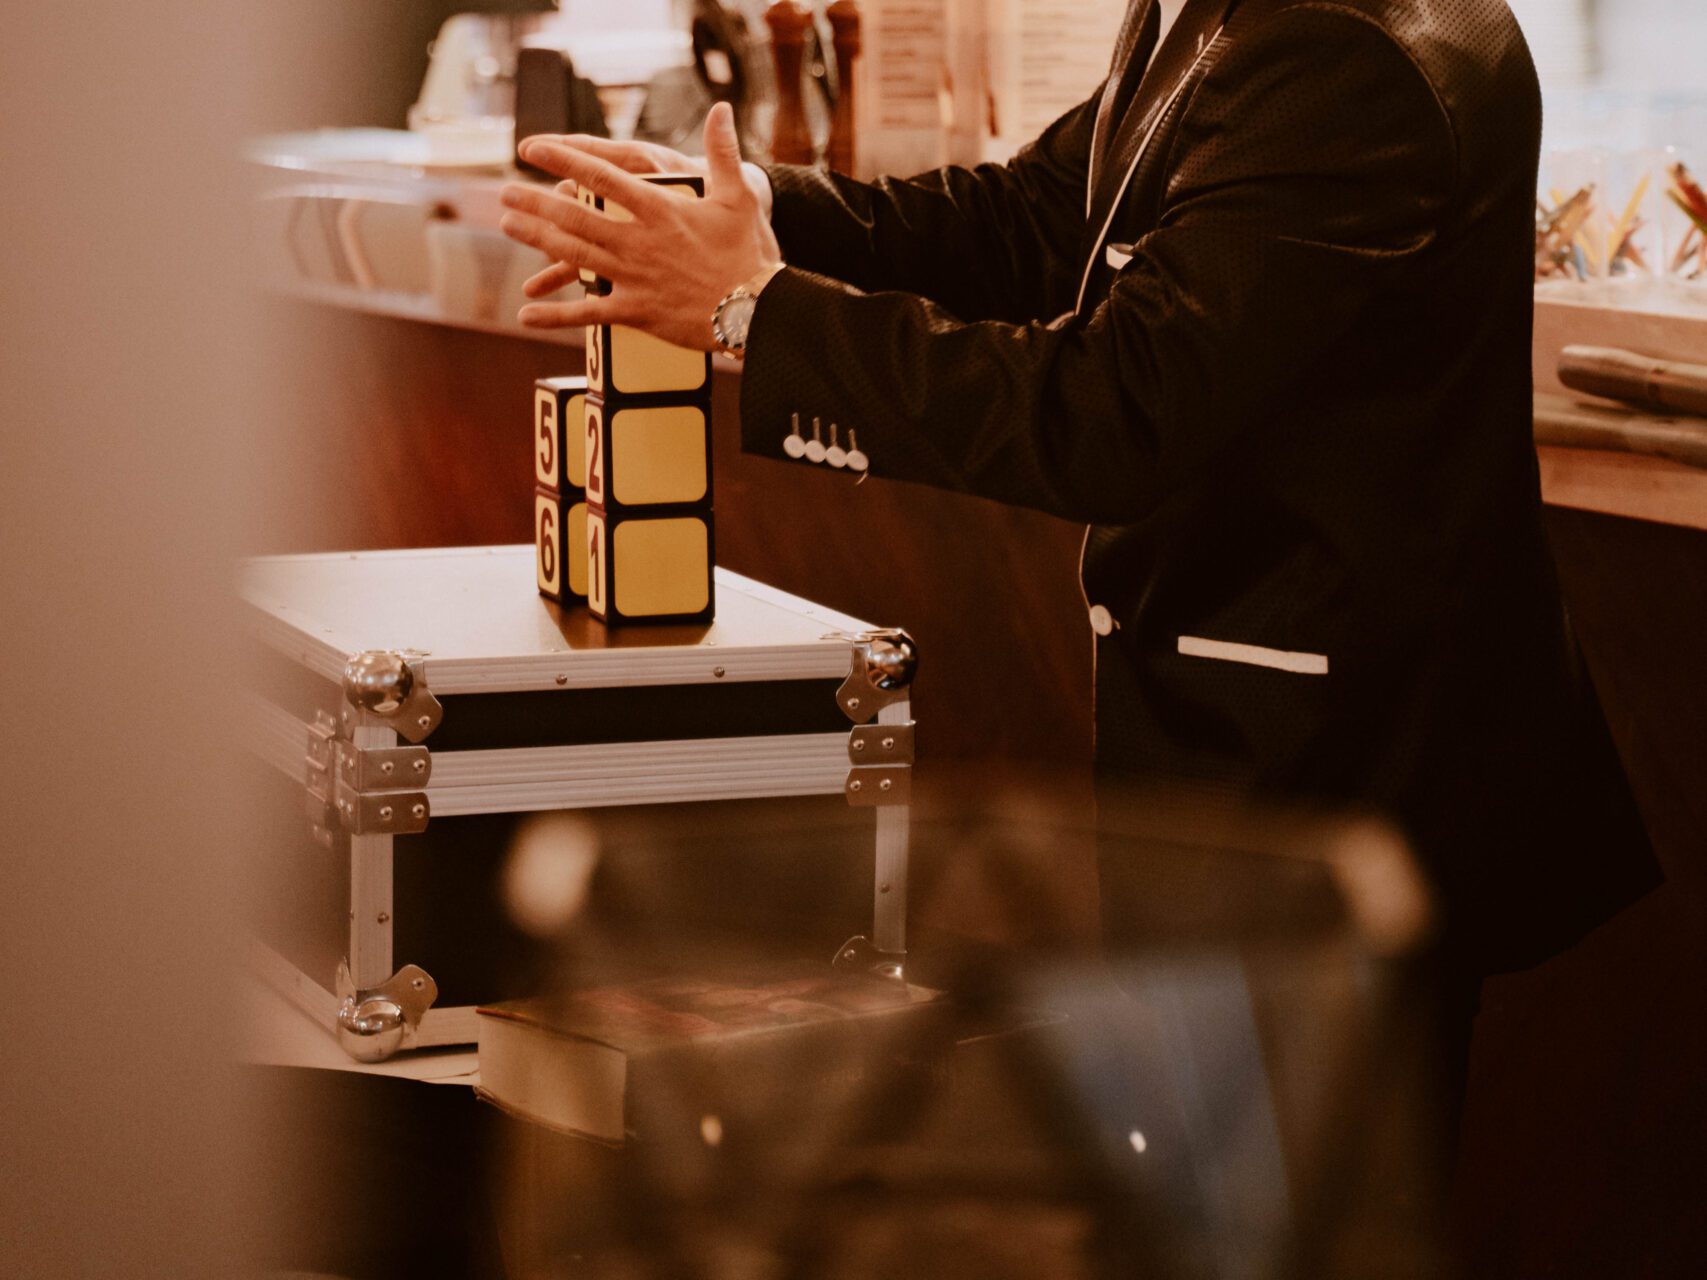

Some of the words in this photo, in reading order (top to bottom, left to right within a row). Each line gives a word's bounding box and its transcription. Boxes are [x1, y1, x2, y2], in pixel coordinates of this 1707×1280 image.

[540, 400, 553, 475] 5
[588, 415, 600, 493] 2
[541, 507, 555, 583] 6
[590, 526, 599, 603] 1
